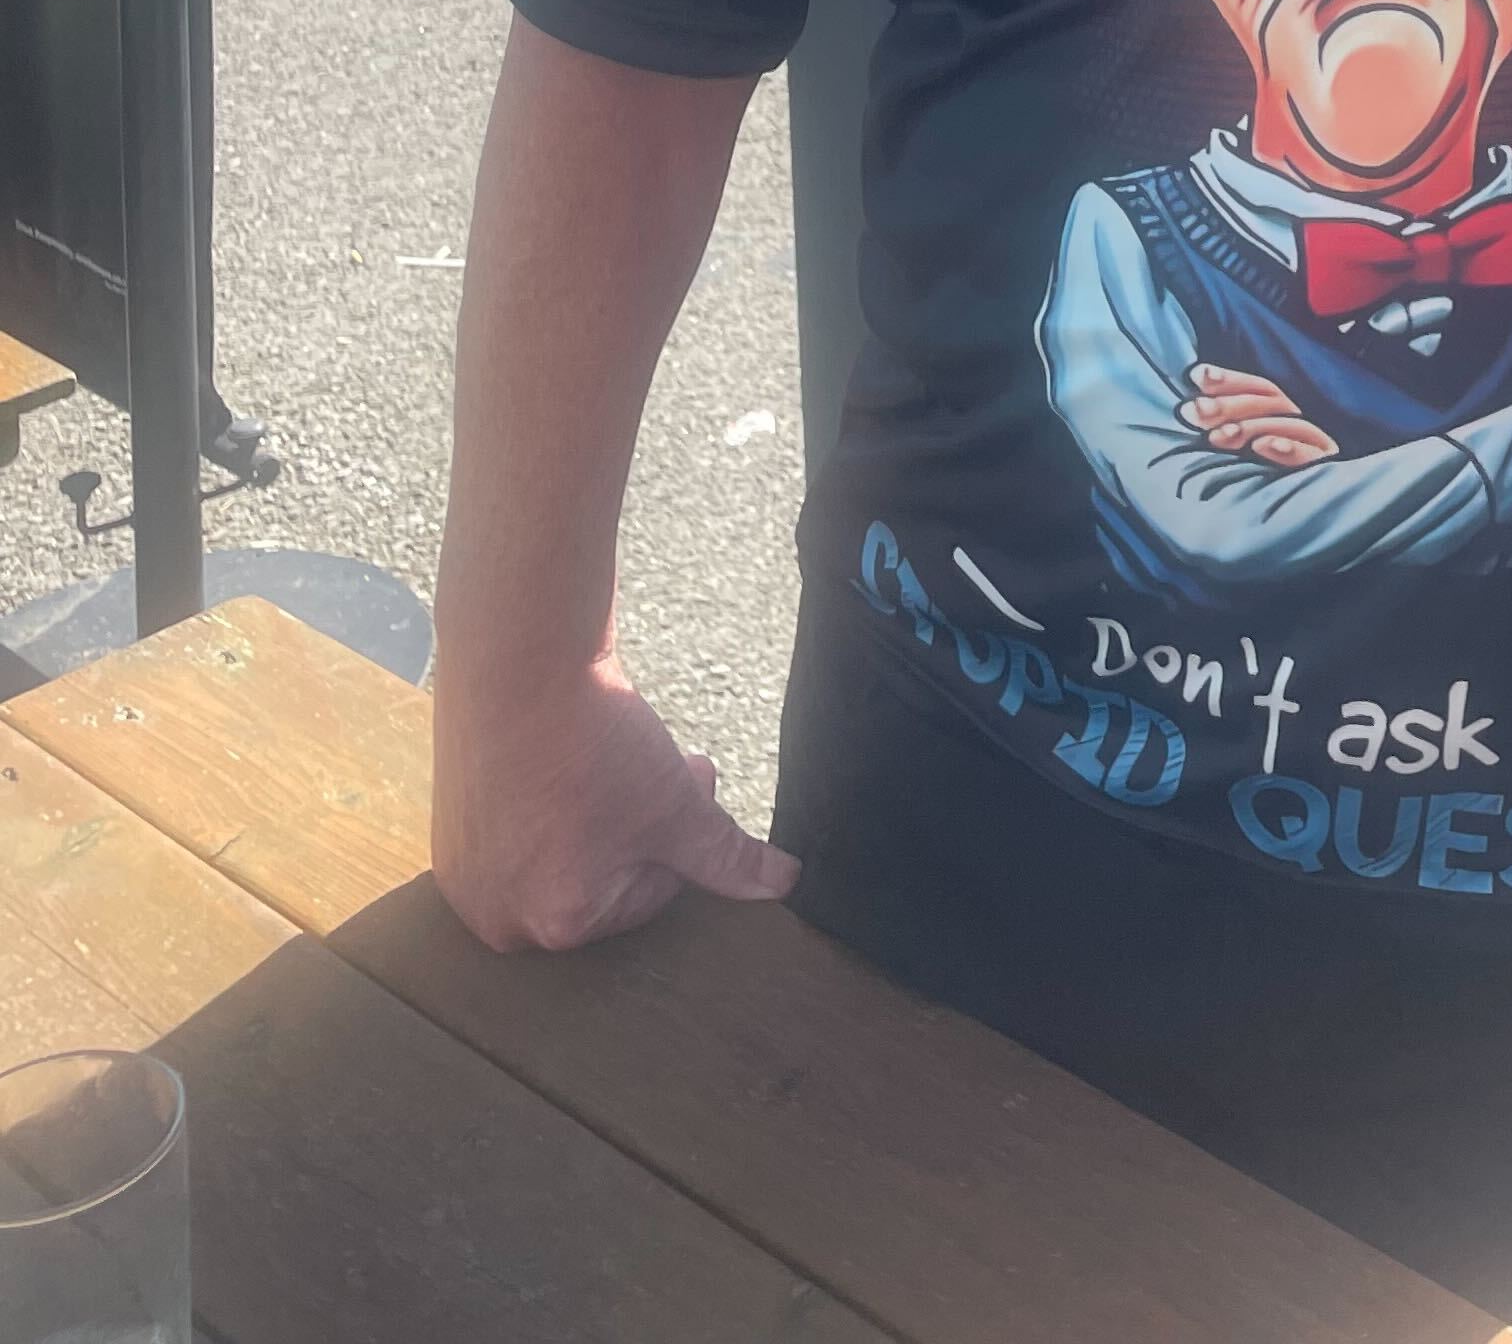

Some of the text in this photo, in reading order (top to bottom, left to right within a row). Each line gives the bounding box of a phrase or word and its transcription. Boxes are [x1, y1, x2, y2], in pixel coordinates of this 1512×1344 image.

[849, 520, 1186, 807] STUPID
[1087, 617, 1300, 774] Don't
[1327, 680, 1500, 774] ask
